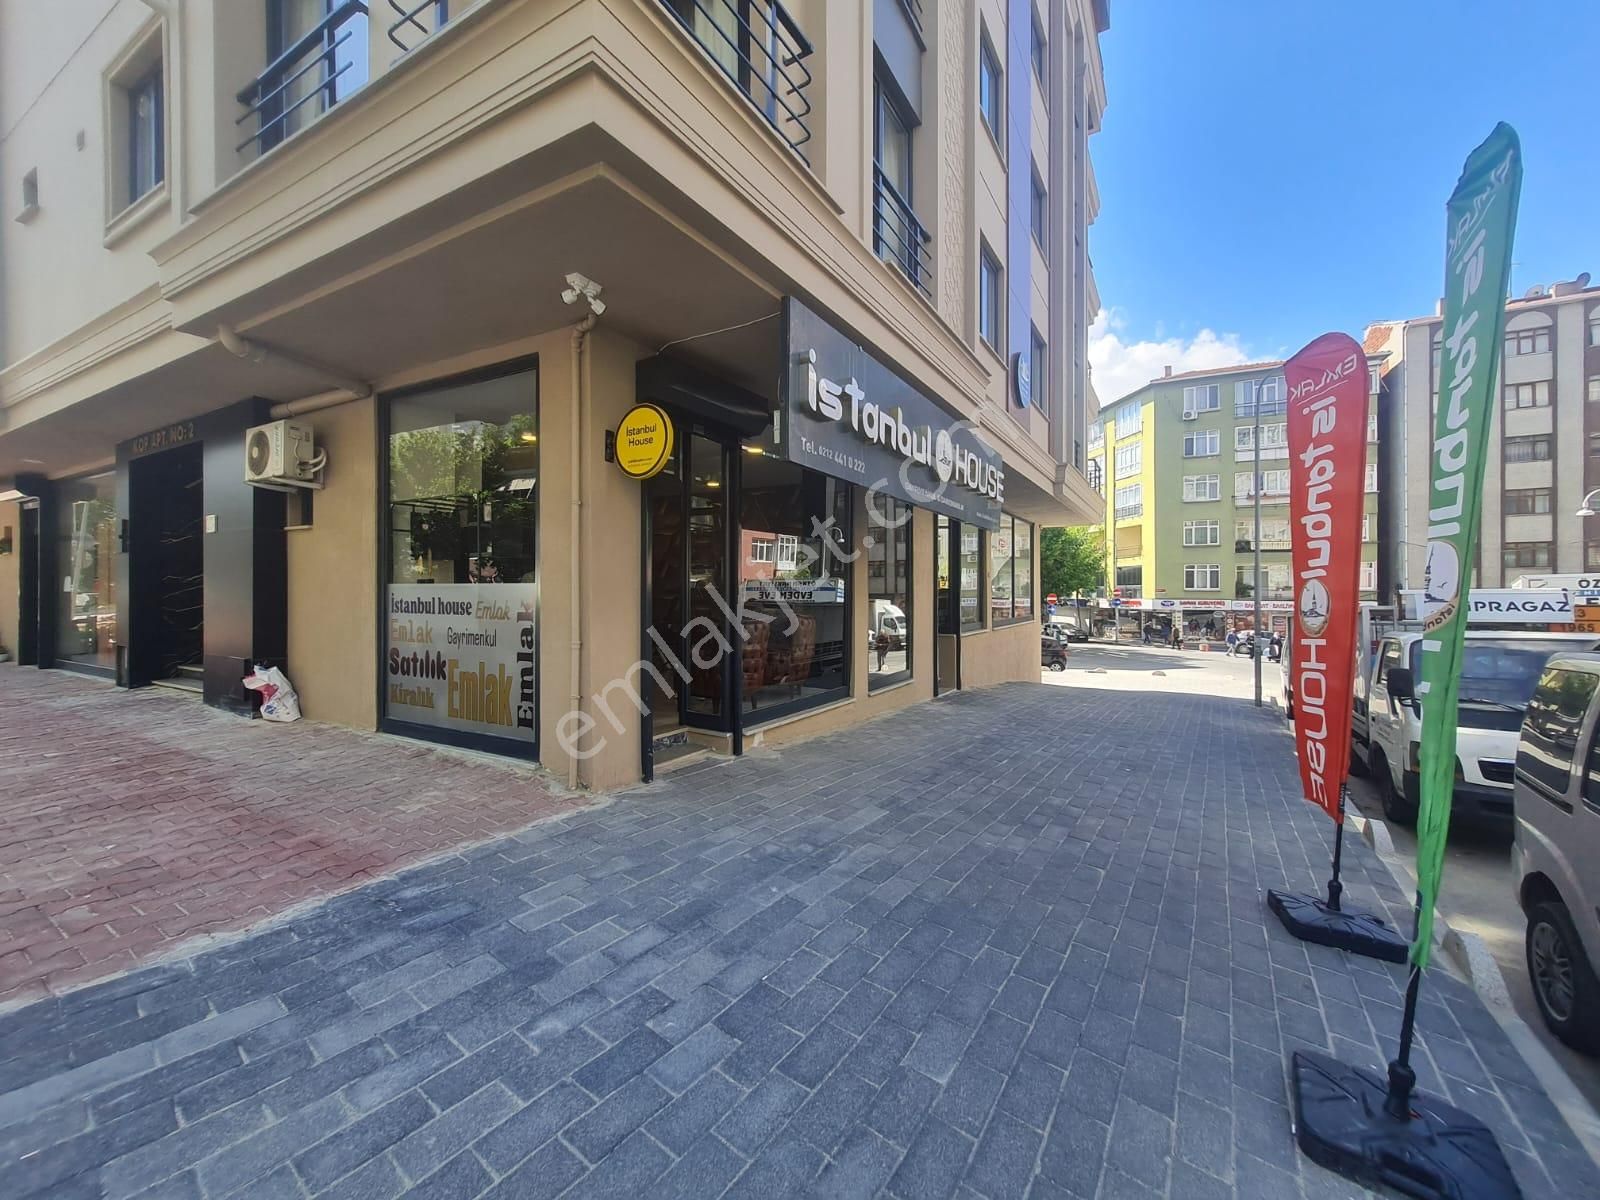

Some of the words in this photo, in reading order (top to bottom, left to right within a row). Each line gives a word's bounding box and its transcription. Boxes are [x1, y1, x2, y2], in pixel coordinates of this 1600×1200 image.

[807, 348, 932, 467] istanbul
[955, 444, 1005, 504] HOUSE
[628, 436, 654, 448] House
[801, 436, 817, 455] Tel.
[819, 446, 833, 460] 0212
[835, 451, 847, 467] 441
[854, 459, 866, 473] 222
[438, 597, 473, 616] house
[475, 601, 511, 621] Emlak
[391, 619, 433, 644] Emlak
[447, 626, 497, 650] Gayrimenkul
[389, 647, 447, 681] Satılık
[517, 601, 534, 729] Emlak
[390, 682, 434, 709] Kiralık
[447, 658, 513, 727] Emlak
